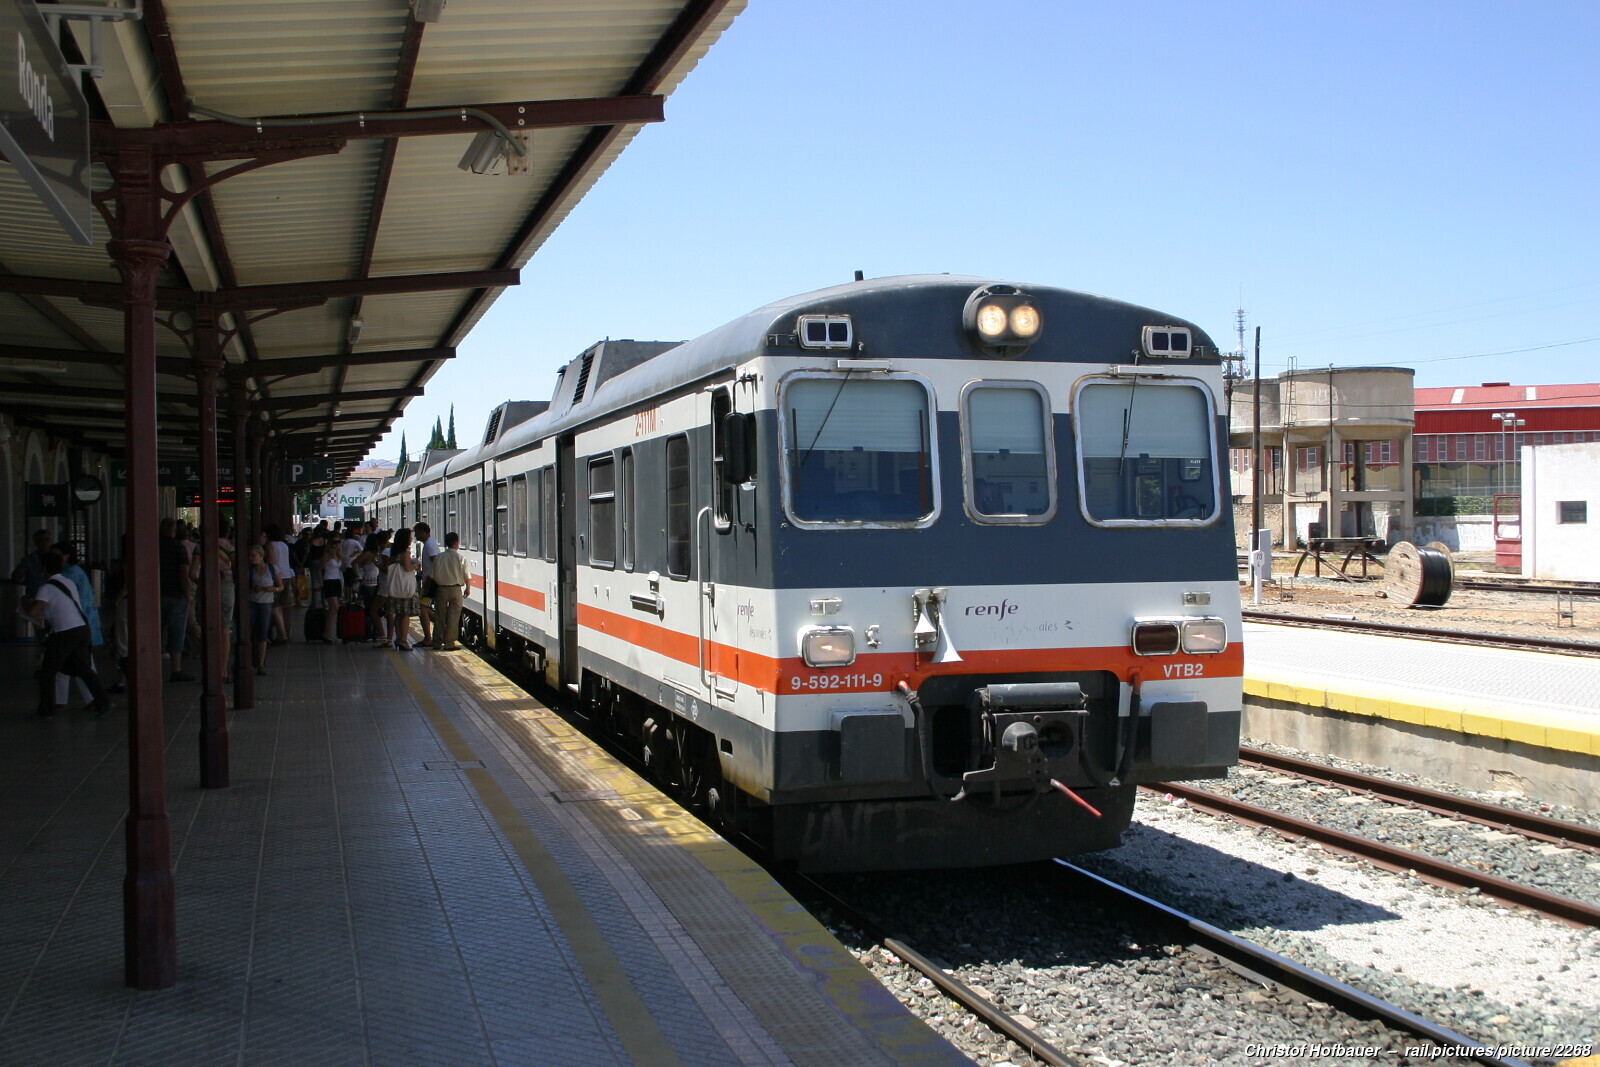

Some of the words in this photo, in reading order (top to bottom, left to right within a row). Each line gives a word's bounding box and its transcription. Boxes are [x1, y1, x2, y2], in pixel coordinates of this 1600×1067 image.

[18, 32, 55, 142] Ronda
[292, 464, 303, 482] P
[326, 468, 333, 479] 5
[737, 598, 755, 623] renfe
[964, 598, 1019, 622] renfe
[1162, 663, 1205, 678] VTB2
[790, 673, 883, 691] 9-592-111-9
